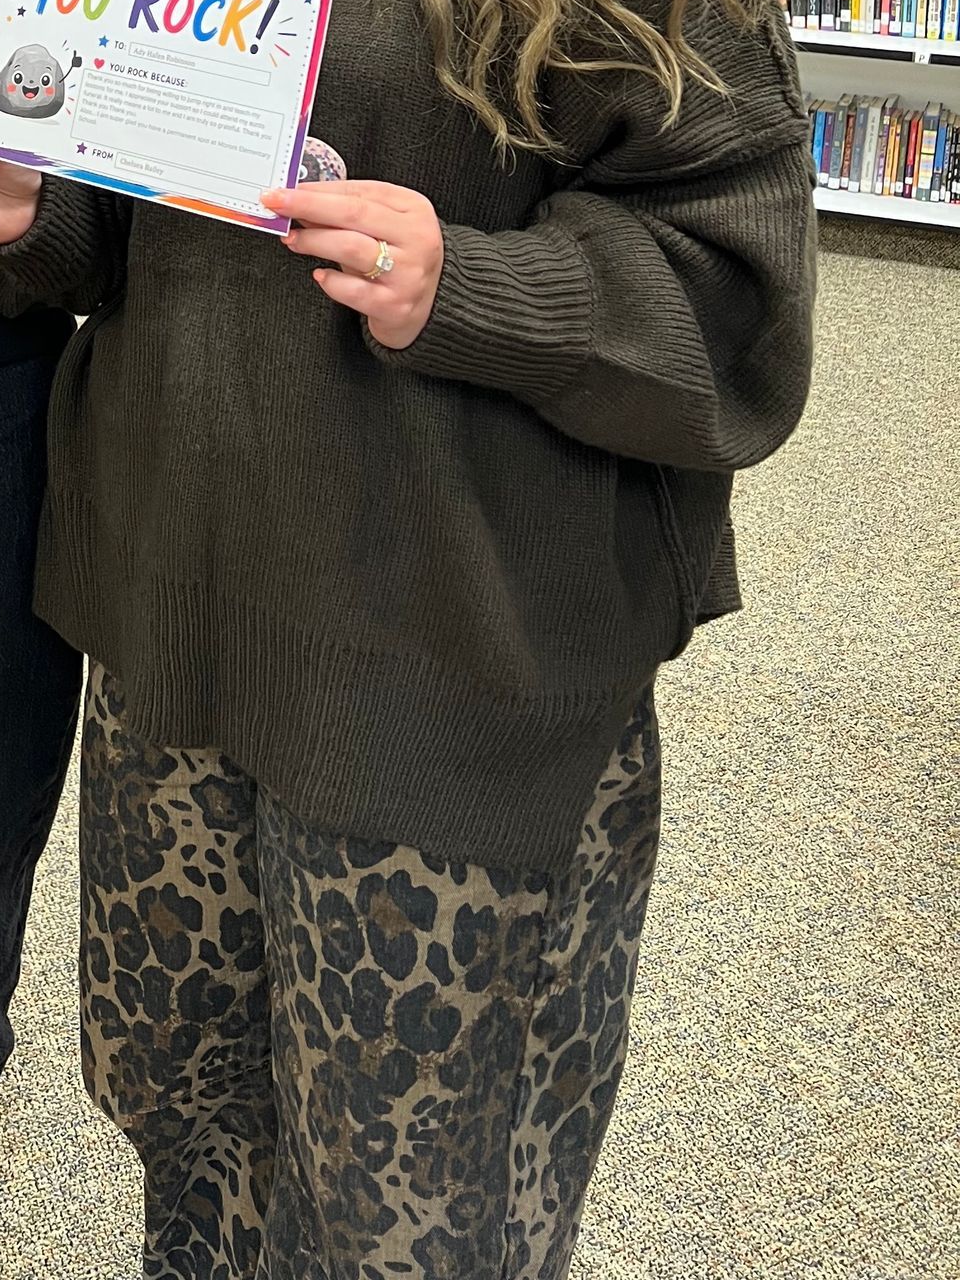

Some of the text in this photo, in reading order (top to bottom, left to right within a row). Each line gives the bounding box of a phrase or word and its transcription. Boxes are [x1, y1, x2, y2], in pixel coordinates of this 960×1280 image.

[114, 40, 127, 50] TO:
[108, 62, 189, 88] YOU ROCK BECAUSE:
[91, 148, 114, 160] FROM
